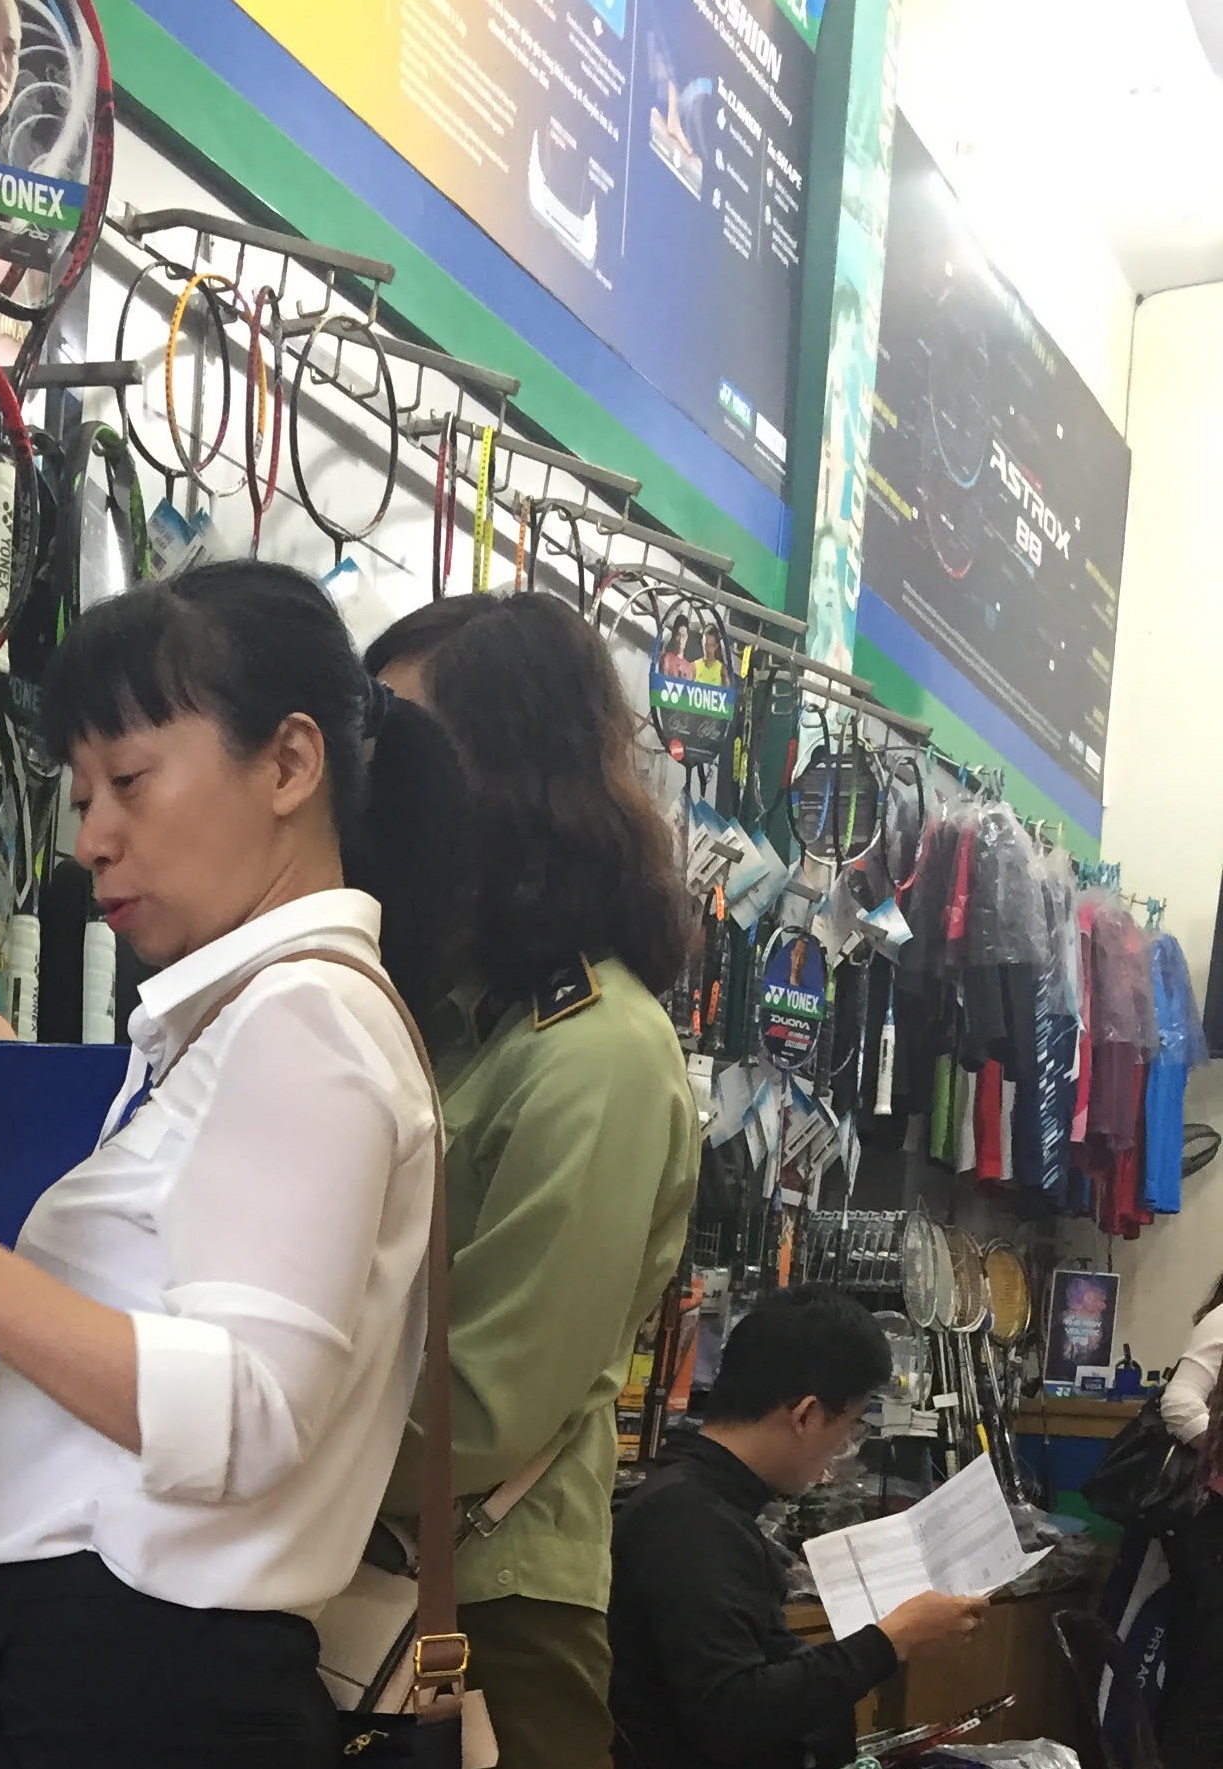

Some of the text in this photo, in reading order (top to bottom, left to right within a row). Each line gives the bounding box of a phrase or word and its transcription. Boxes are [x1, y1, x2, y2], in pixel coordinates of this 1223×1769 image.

[990, 439, 1071, 560] ASTROX
[1015, 515, 1043, 568] 88
[686, 685, 728, 714] YONEX
[786, 988, 820, 1014] YONEX
